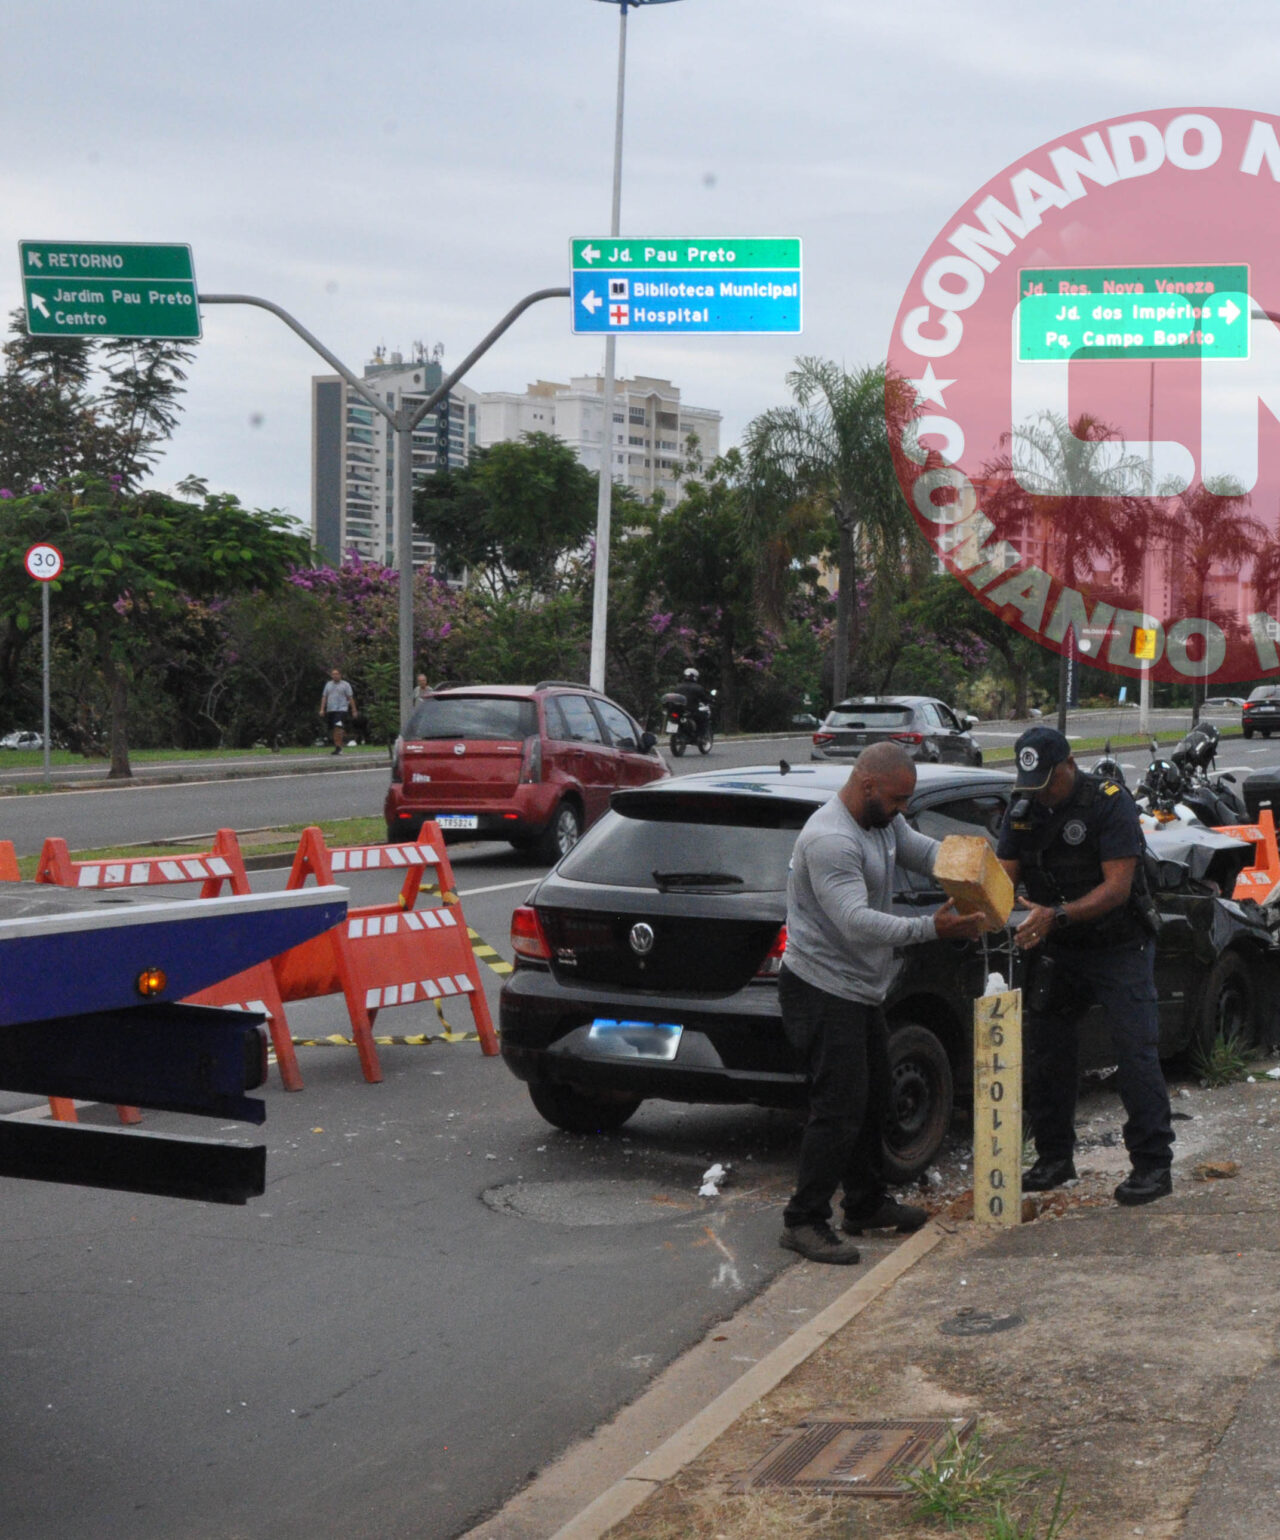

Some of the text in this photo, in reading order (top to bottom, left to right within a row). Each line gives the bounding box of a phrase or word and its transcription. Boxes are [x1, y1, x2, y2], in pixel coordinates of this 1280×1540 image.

[48, 253, 124, 269] RETORNO
[608, 248, 736, 262] Jd. Pau Preto
[634, 282, 797, 300] Biblioteca Municipal
[1023, 279, 1215, 296] Jd. Res. Nova Veneza
[53, 289, 193, 305] Jardim Pau Preto
[55, 311, 107, 325] Centro
[634, 308, 708, 324] Hospital
[1056, 302, 1211, 321] Jd. dos Impérios
[1046, 330, 1215, 348] Pq. Campo Bonito
[33, 553, 56, 567] 30
